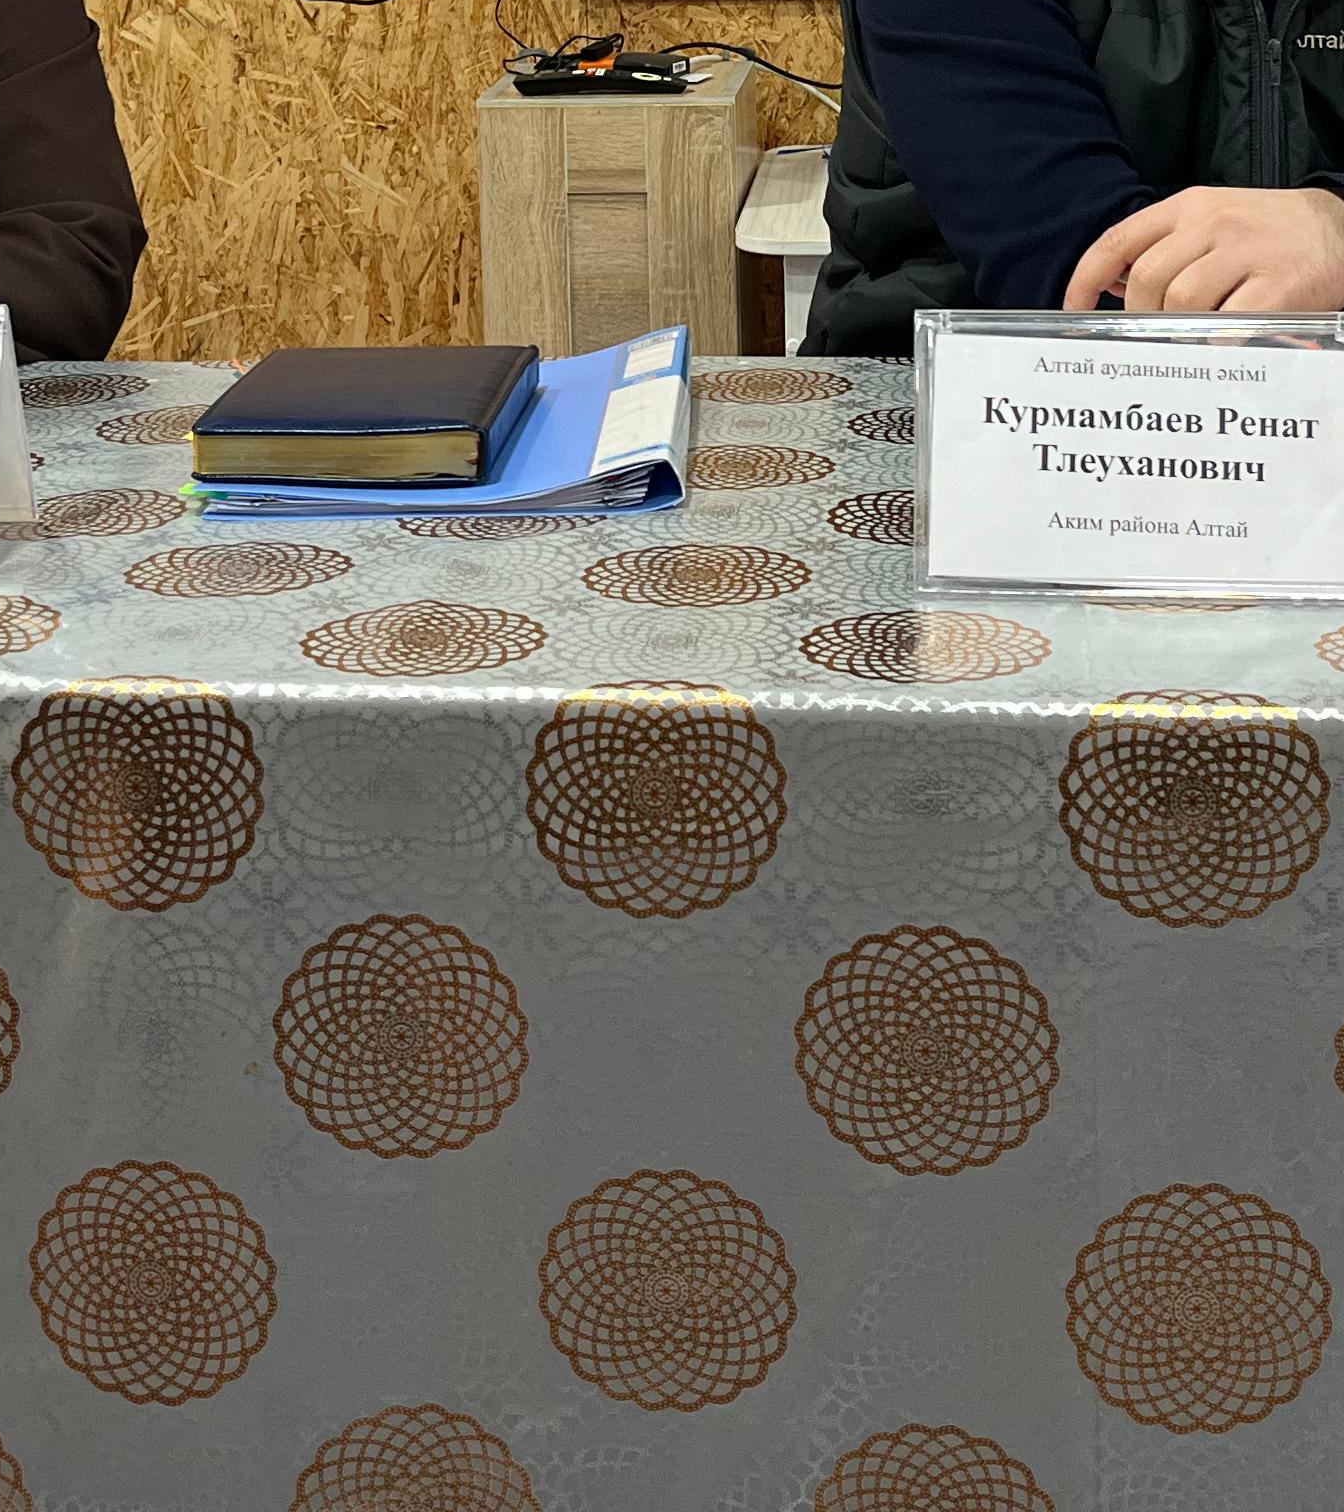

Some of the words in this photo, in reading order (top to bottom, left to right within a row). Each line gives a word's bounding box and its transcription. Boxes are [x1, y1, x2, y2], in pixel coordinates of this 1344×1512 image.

[1033, 355, 1095, 376] Алтай
[1099, 360, 1212, 382] ауданының
[1216, 363, 1268, 383] әкімі
[981, 395, 1204, 435] Курмамбаев
[1215, 406, 1321, 440] Ренат
[1032, 442, 1267, 483] Тлеуханович
[1047, 510, 1105, 532] Аким
[1108, 512, 1181, 537] района
[1185, 516, 1249, 539] Алтай
